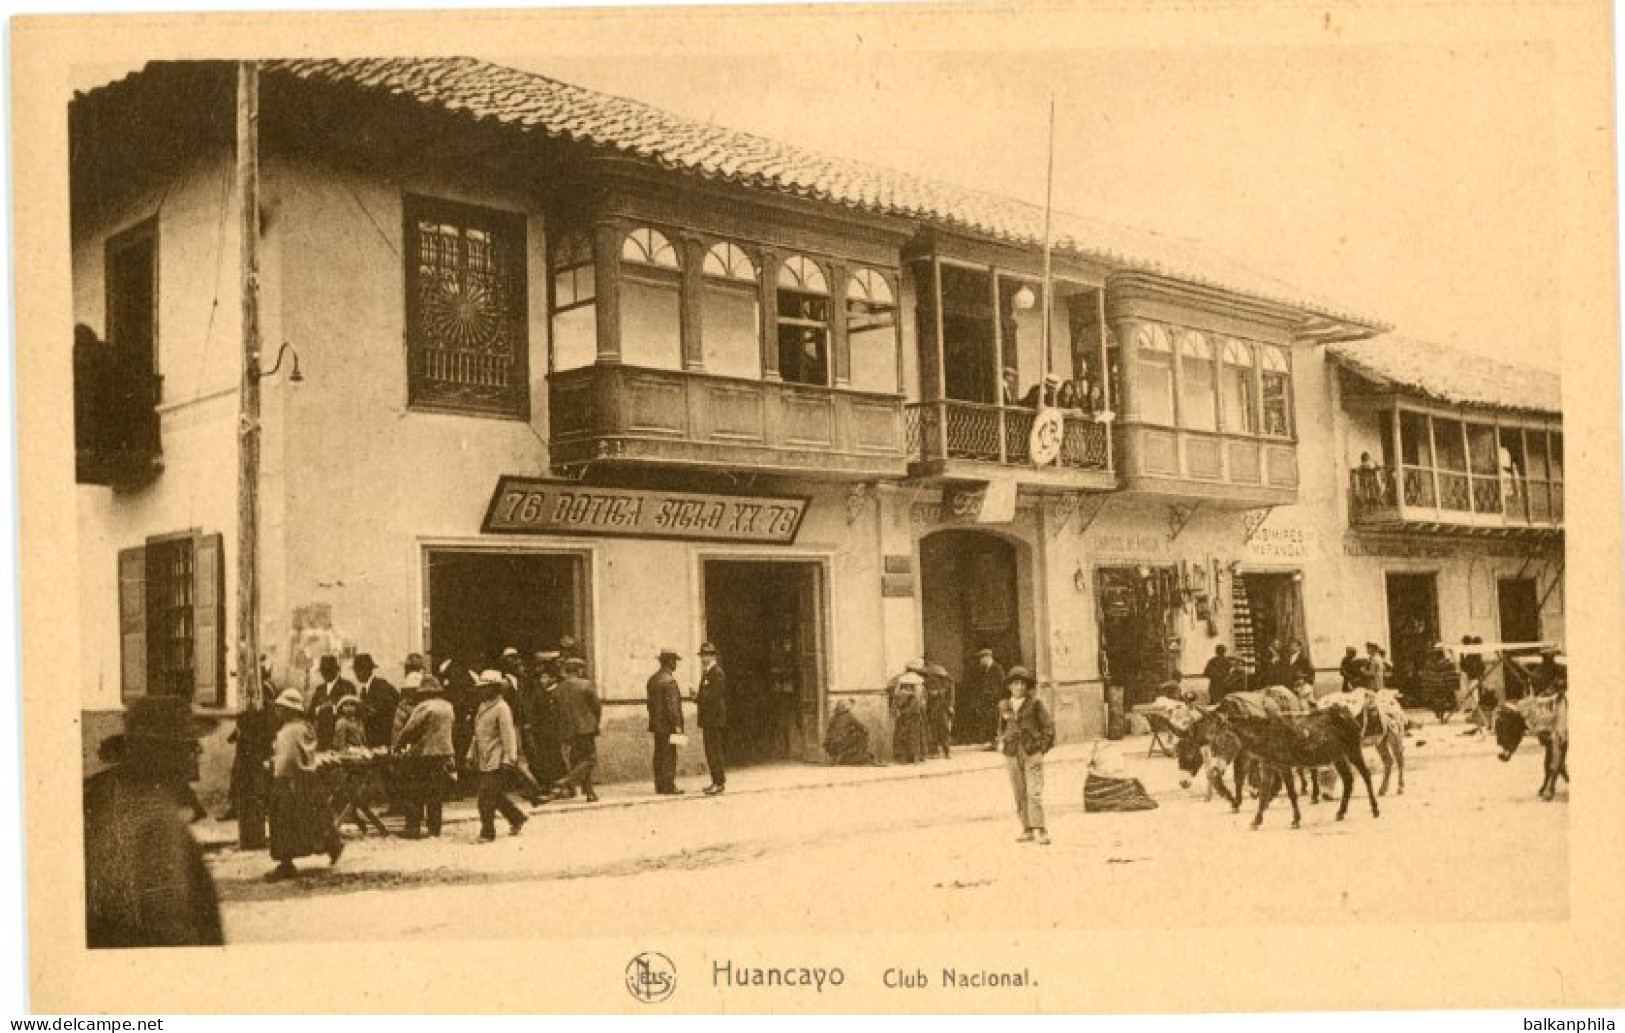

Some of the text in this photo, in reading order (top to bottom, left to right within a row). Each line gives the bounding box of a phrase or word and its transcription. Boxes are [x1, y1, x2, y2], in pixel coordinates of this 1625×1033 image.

[504, 490, 545, 522] 76
[550, 492, 644, 526] BOTICA
[654, 498, 726, 528] SIGLO
[729, 503, 762, 532] XX
